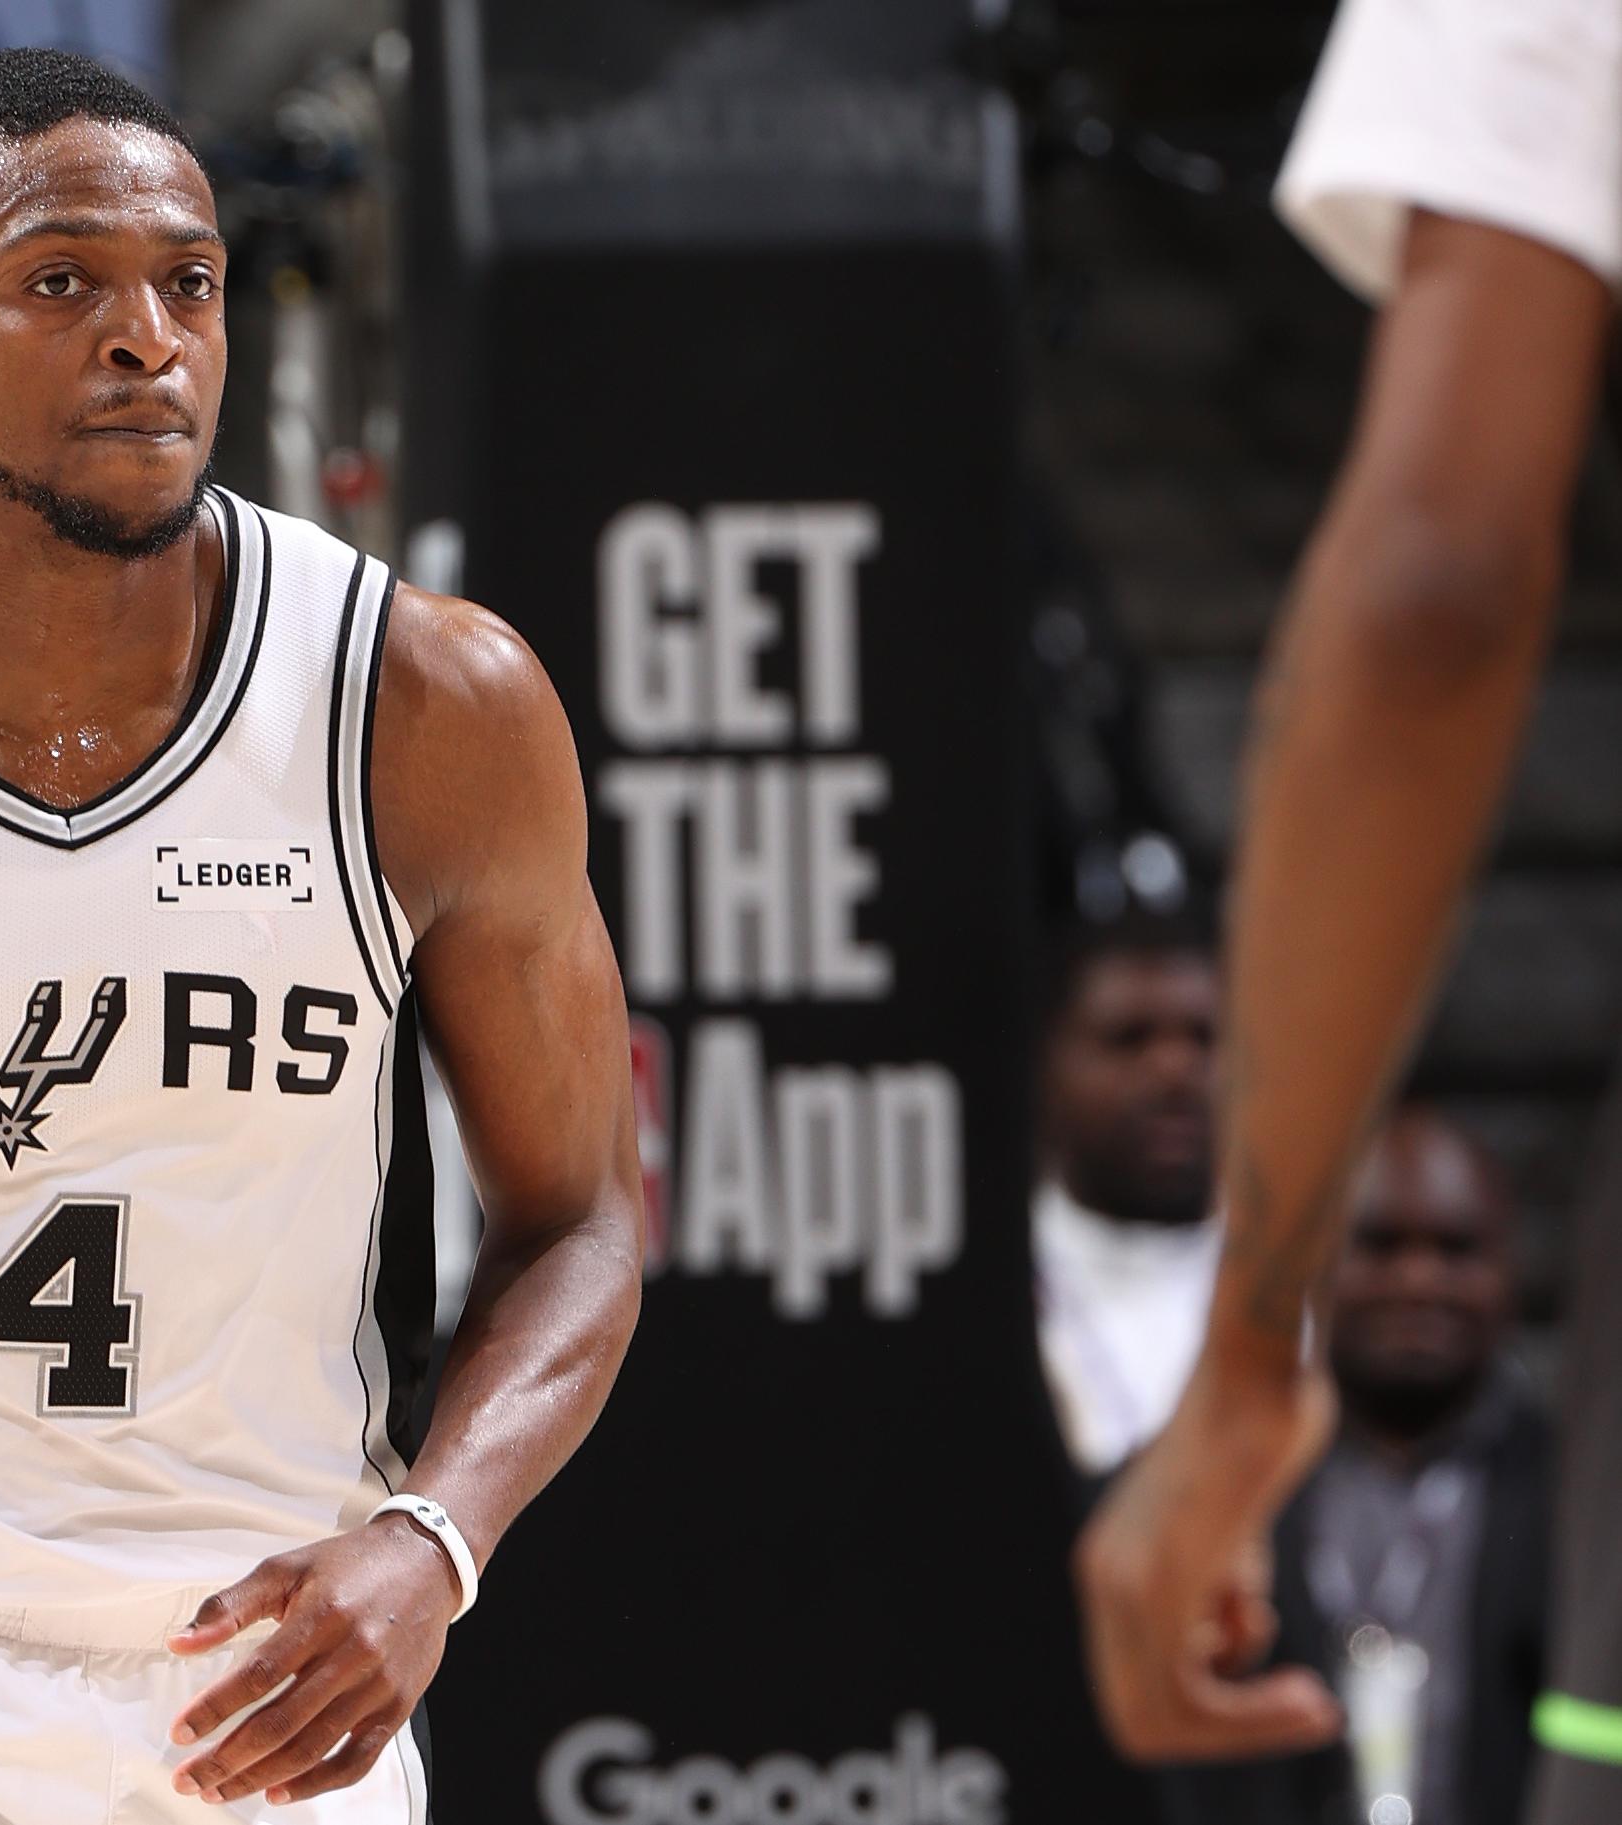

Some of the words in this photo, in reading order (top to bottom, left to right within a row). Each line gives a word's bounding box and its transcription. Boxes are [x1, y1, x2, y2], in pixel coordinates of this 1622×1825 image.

[598, 503, 880, 748] GET
[177, 863, 292, 886] LEDGER
[598, 758, 892, 1003] THE
[681, 1018, 964, 1320] App
